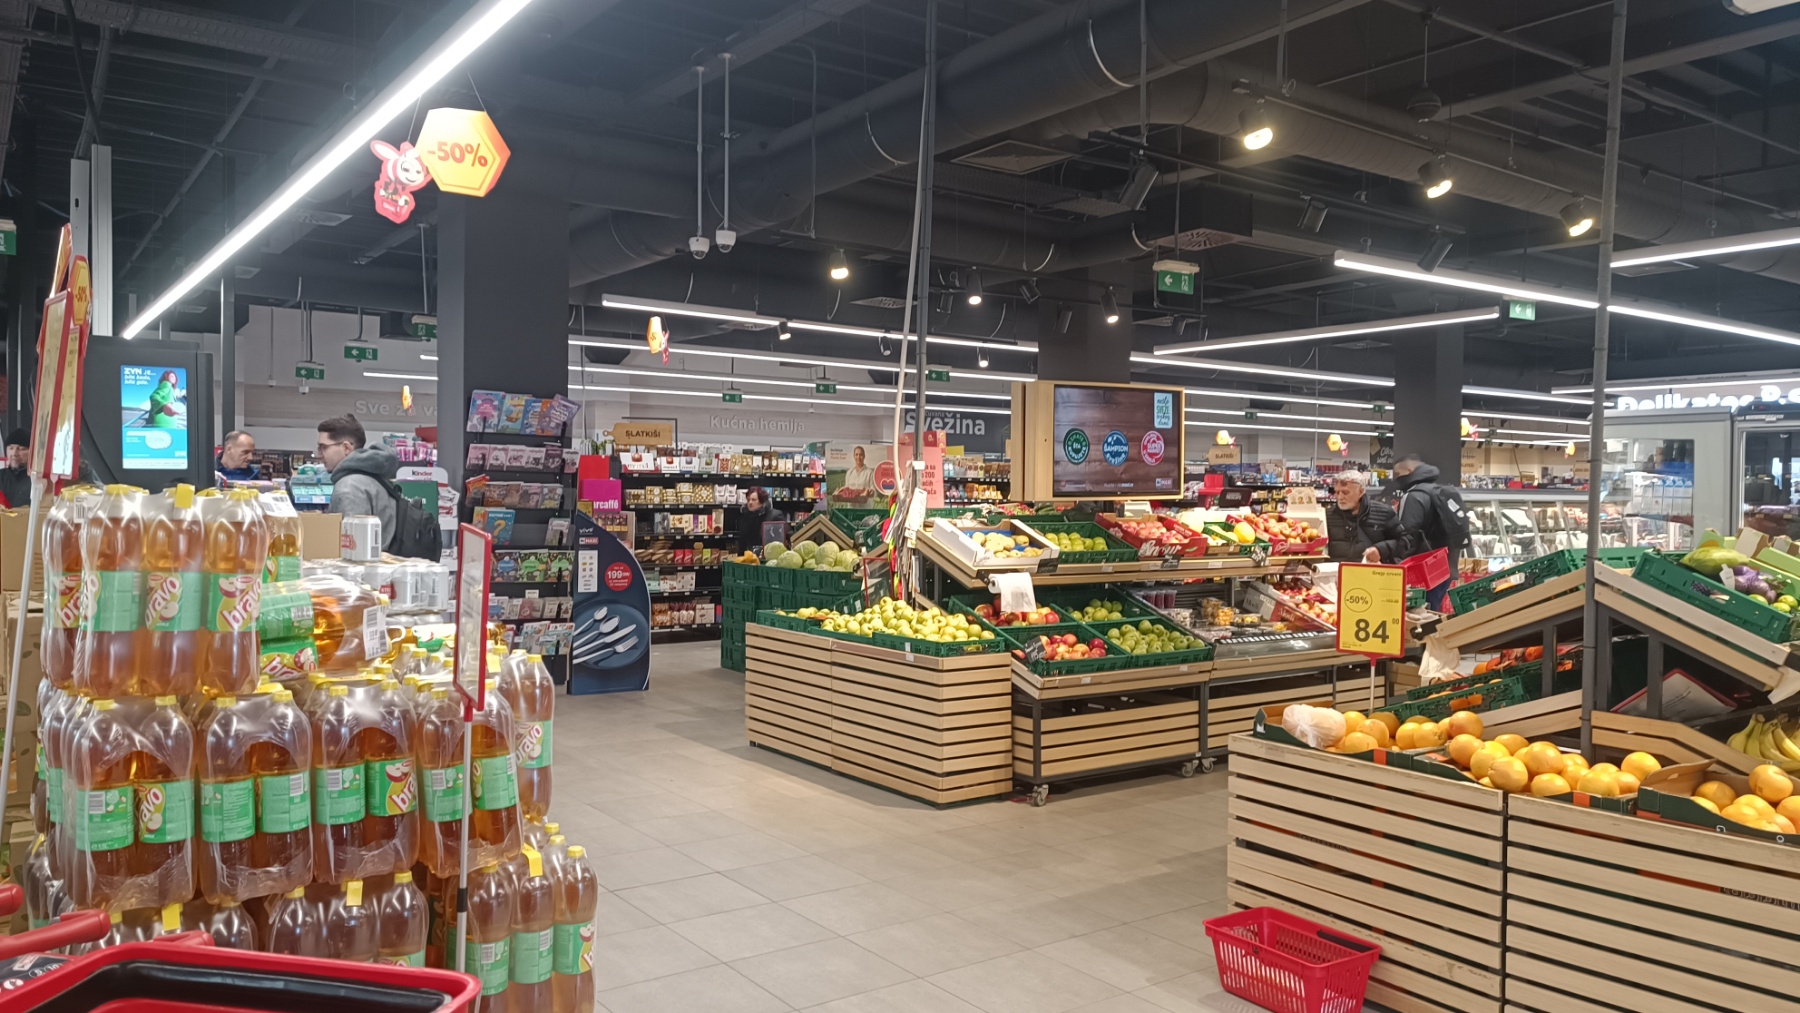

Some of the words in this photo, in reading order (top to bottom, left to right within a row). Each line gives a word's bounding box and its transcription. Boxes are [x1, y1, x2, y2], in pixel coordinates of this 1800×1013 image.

[427, 141, 488, 167] -50%
[355, 400, 389, 415] Sve
[710, 414, 757, 430] Kućna
[759, 418, 805, 433] hemija
[625, 429, 660, 438] SLATKIŠI
[607, 570, 622, 579] 199
[1346, 596, 1369, 605] -50%
[1354, 618, 1390, 644] 84
